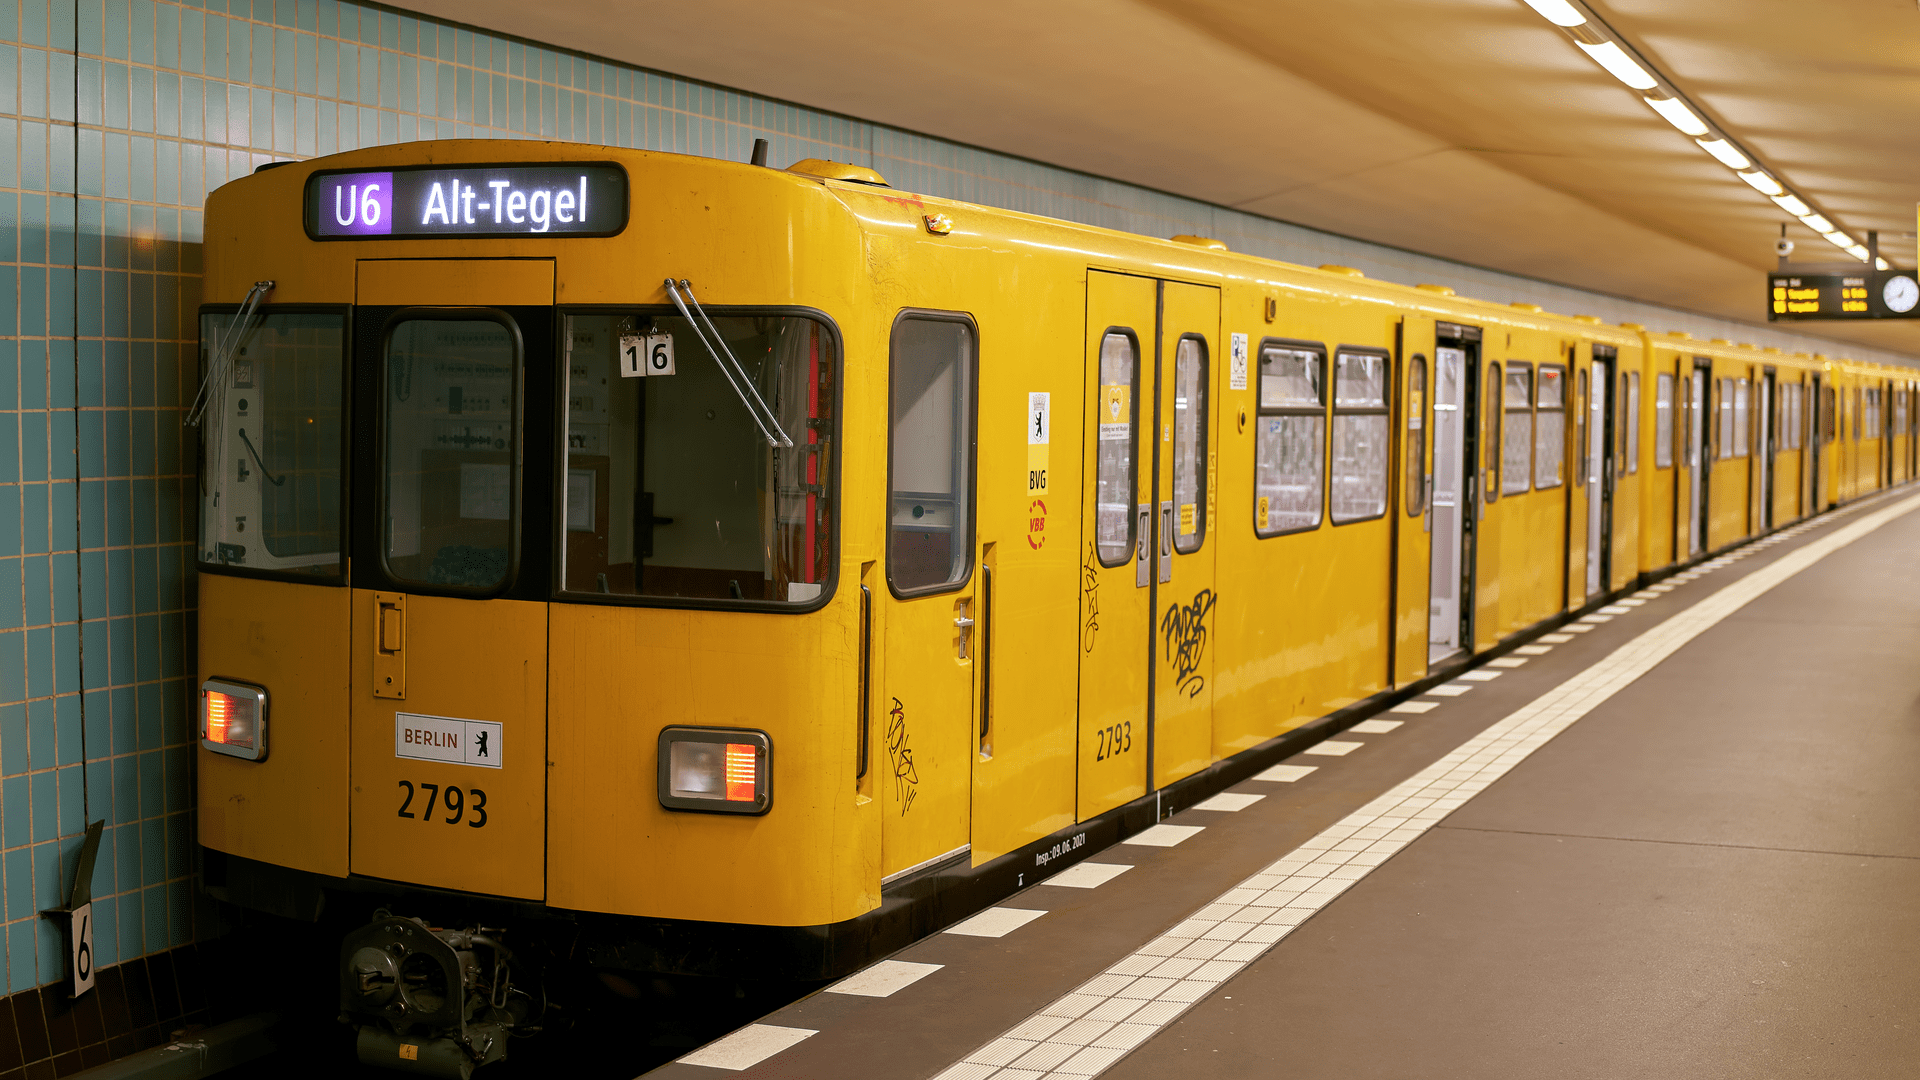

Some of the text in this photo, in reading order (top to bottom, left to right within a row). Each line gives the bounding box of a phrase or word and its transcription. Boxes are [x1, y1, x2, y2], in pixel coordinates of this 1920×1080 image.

[335, 175, 587, 233] U6 Alt-Tegel
[1029, 469, 1046, 490] BVG
[1029, 517, 1045, 533] VBB
[404, 728, 458, 749] BERLIN
[1096, 720, 1131, 762] 2793
[397, 780, 488, 828] 2793
[77, 914, 91, 982] 6
